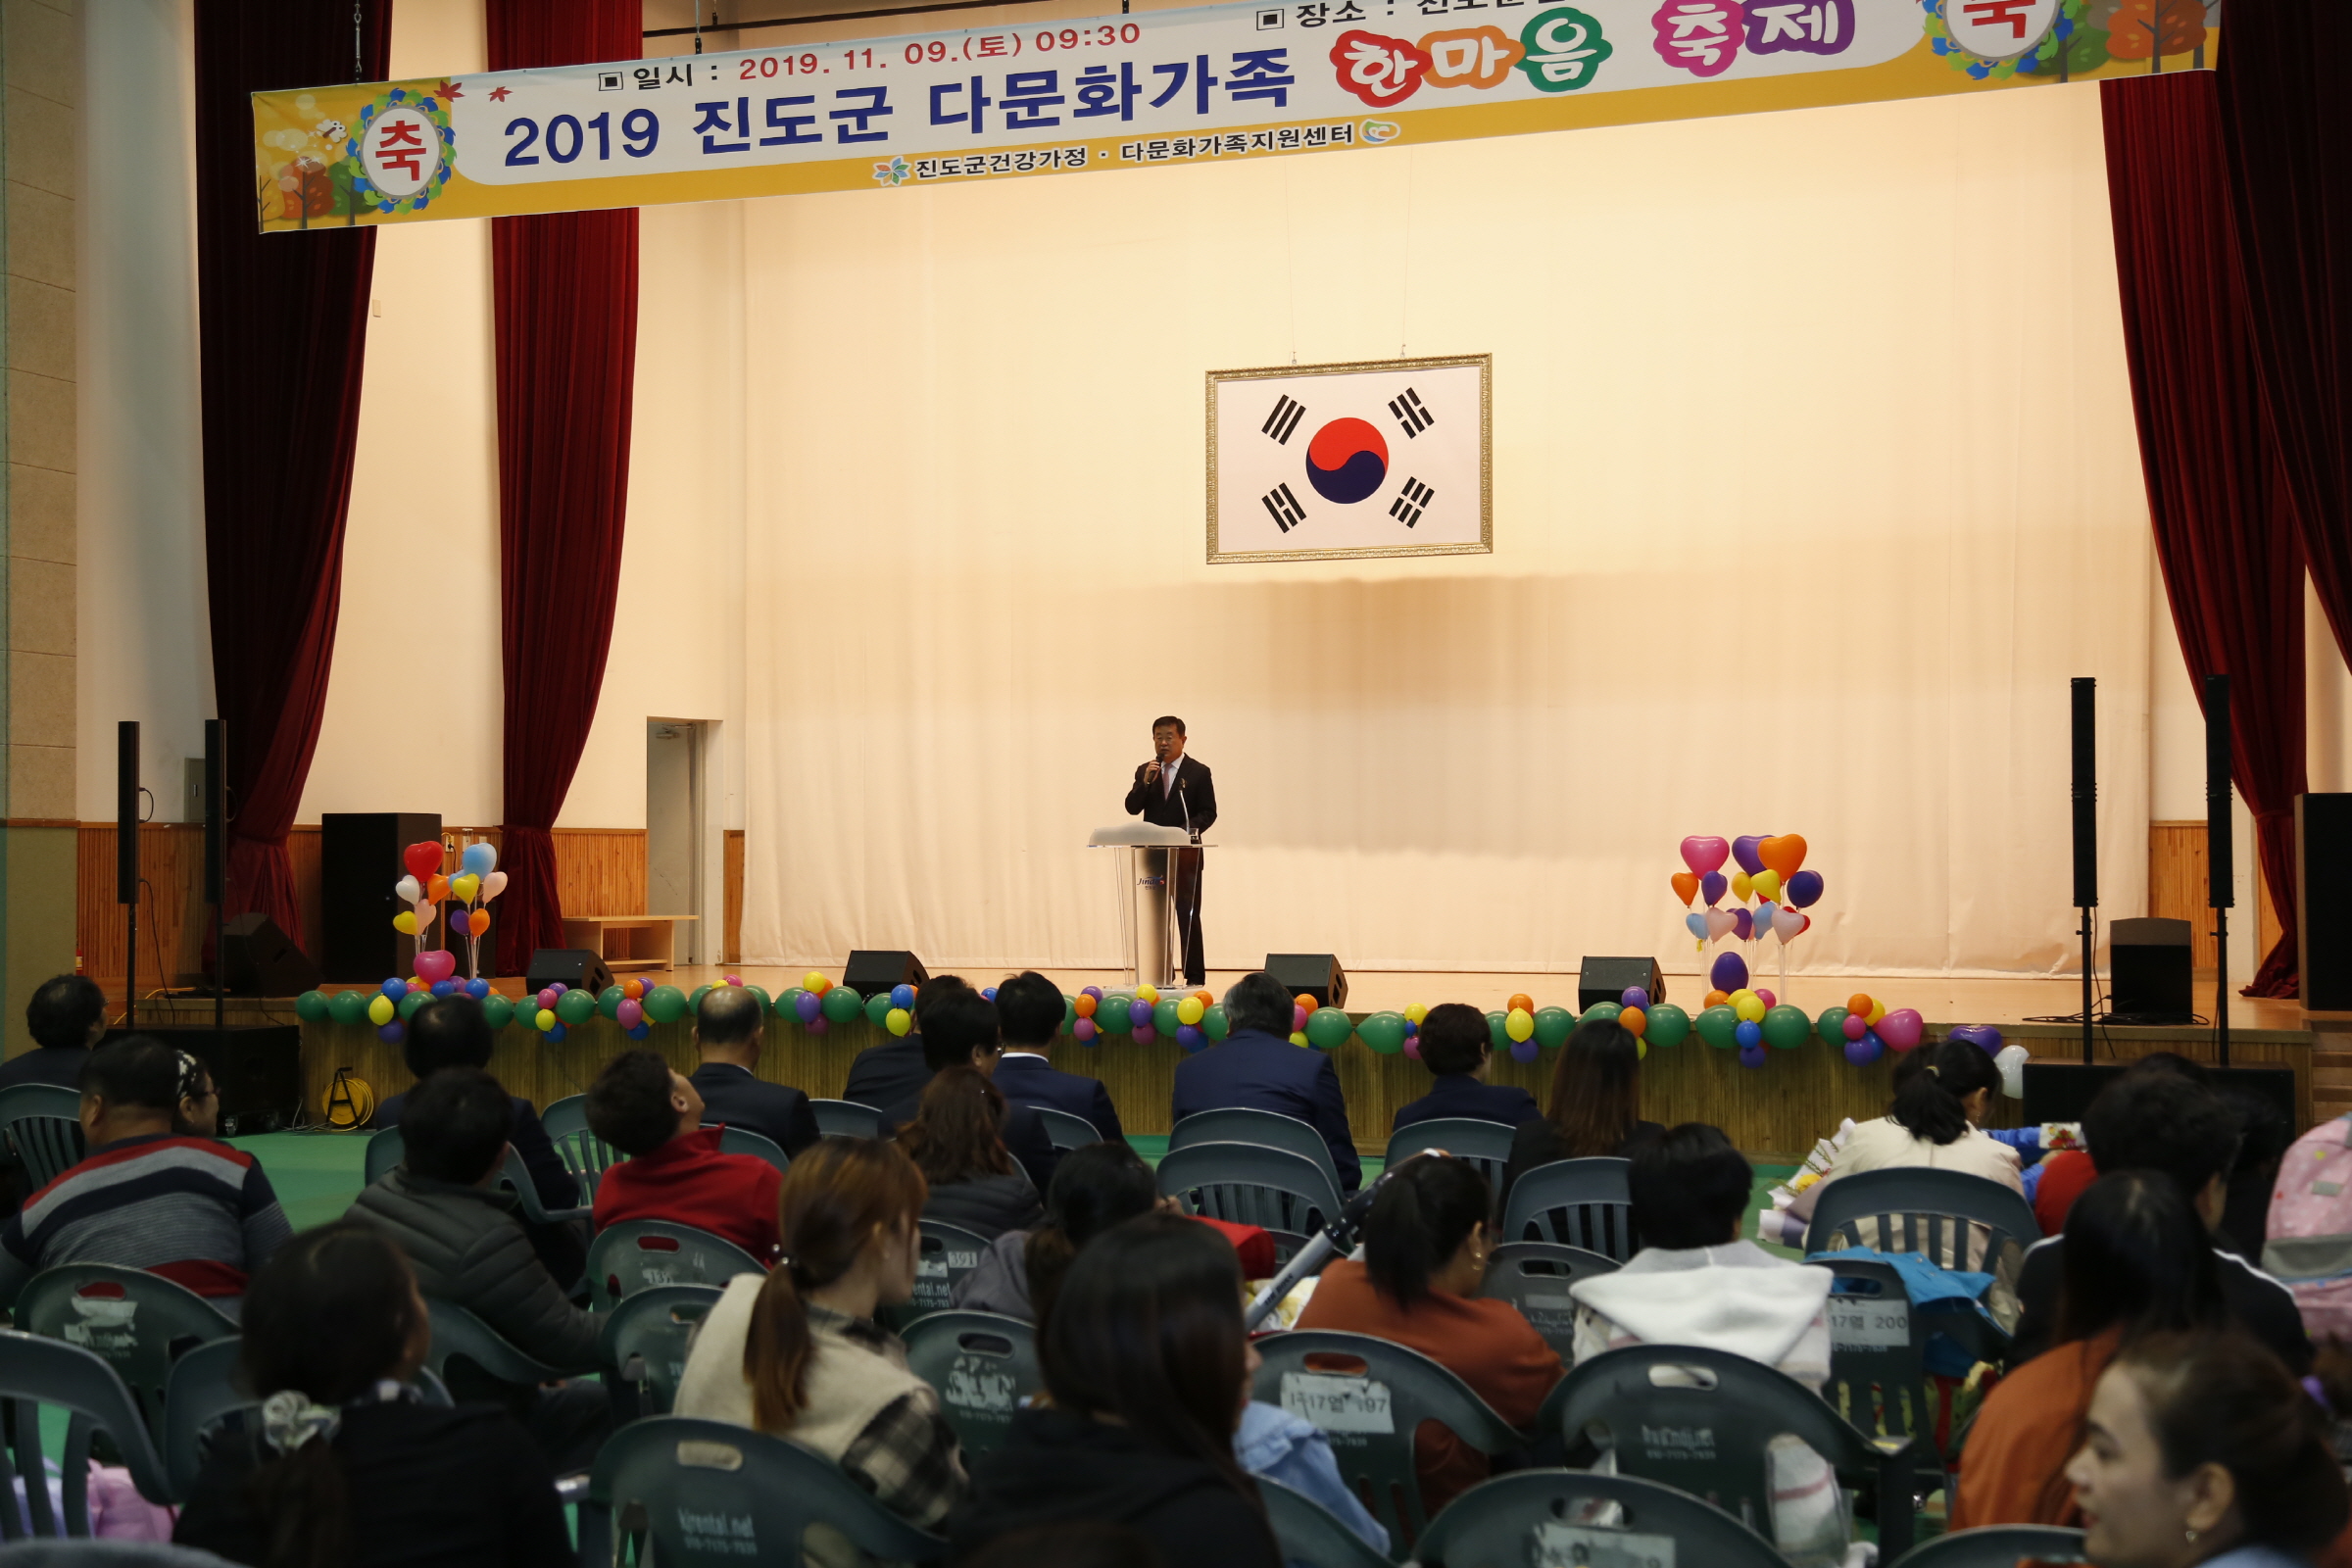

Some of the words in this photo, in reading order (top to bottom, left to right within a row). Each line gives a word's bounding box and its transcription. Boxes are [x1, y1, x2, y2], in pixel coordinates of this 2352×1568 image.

[1296, 1, 1366, 28] 장소
[505, 108, 660, 167] 2019
[693, 85, 893, 155] 진도군
[930, 48, 1295, 134] 다문화가족
[1343, 17, 1598, 97] 한마음
[1667, 0, 1840, 67] 축제
[633, 64, 693, 90] 일시
[740, 53, 830, 80] 2019.
[844, 48, 887, 70] 11.
[905, 32, 1022, 65] 09.(토)
[1036, 23, 1141, 52] 09:30
[375, 120, 427, 181] 축
[915, 147, 1087, 178] 진도군건강가정
[1121, 123, 1352, 162] 다문화가족지원센터
[1875, 1316, 1908, 1330] 200
